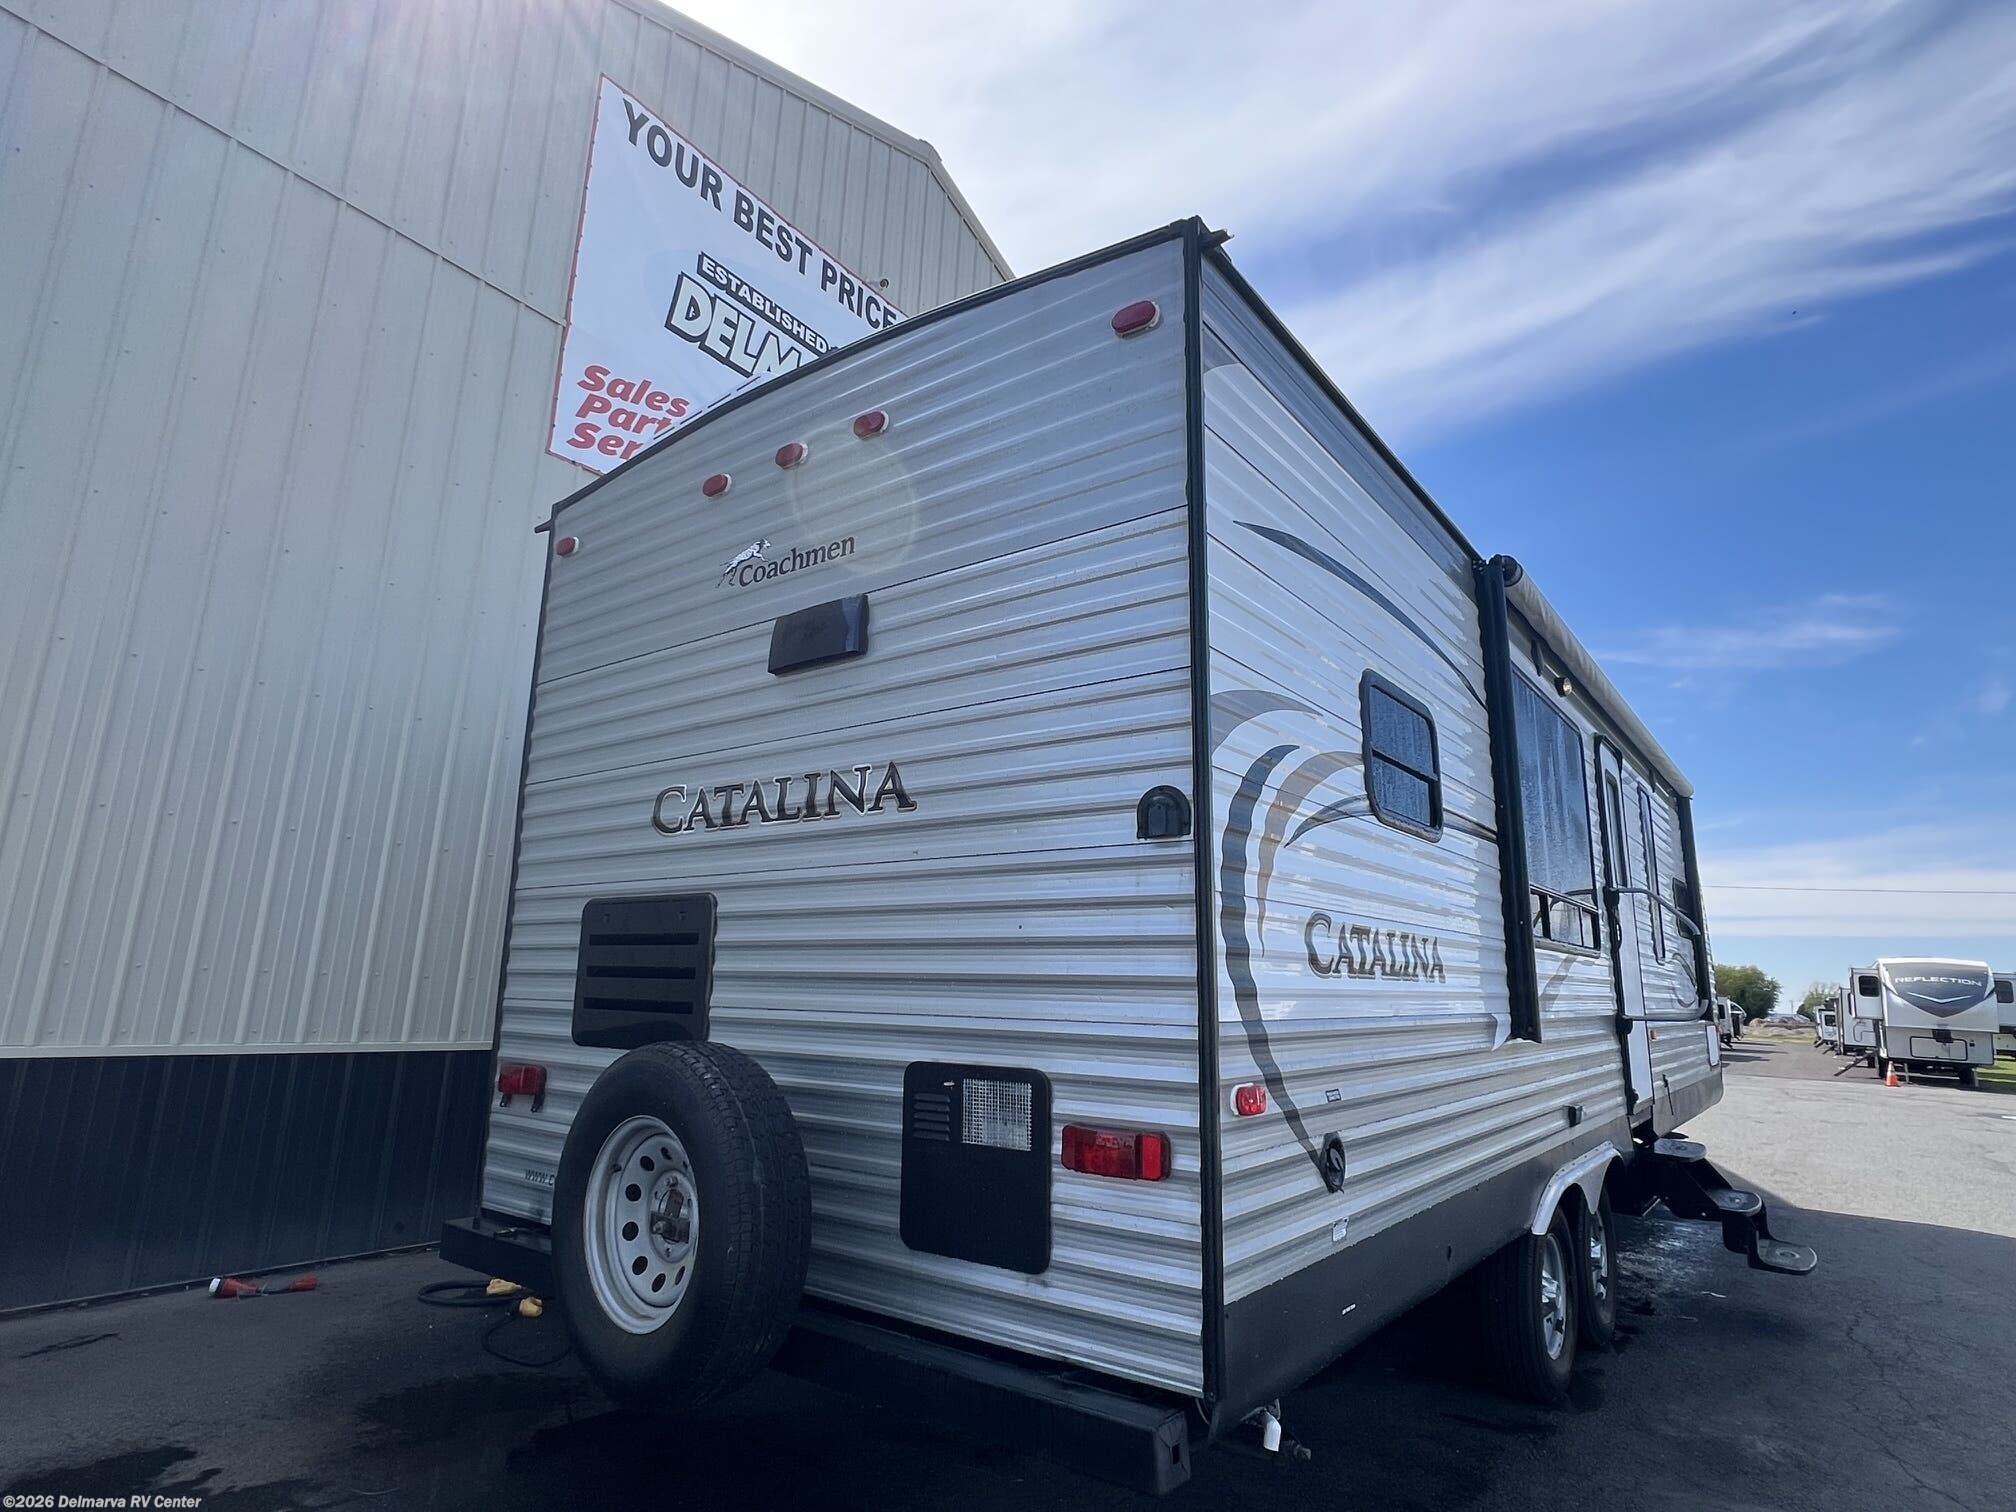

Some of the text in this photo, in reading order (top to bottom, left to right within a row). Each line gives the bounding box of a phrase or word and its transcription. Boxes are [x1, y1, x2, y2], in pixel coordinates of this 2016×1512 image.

[623, 97, 723, 213] YOUR
[733, 188, 814, 276] BEST
[700, 254, 829, 355] ESTABLISHED
[576, 364, 690, 418] Sales
[739, 536, 855, 587] Coachmen
[652, 760, 918, 837] CATALINA
[1304, 910, 1446, 984] CATALINA
[1894, 976, 1983, 987] REFLECTION
